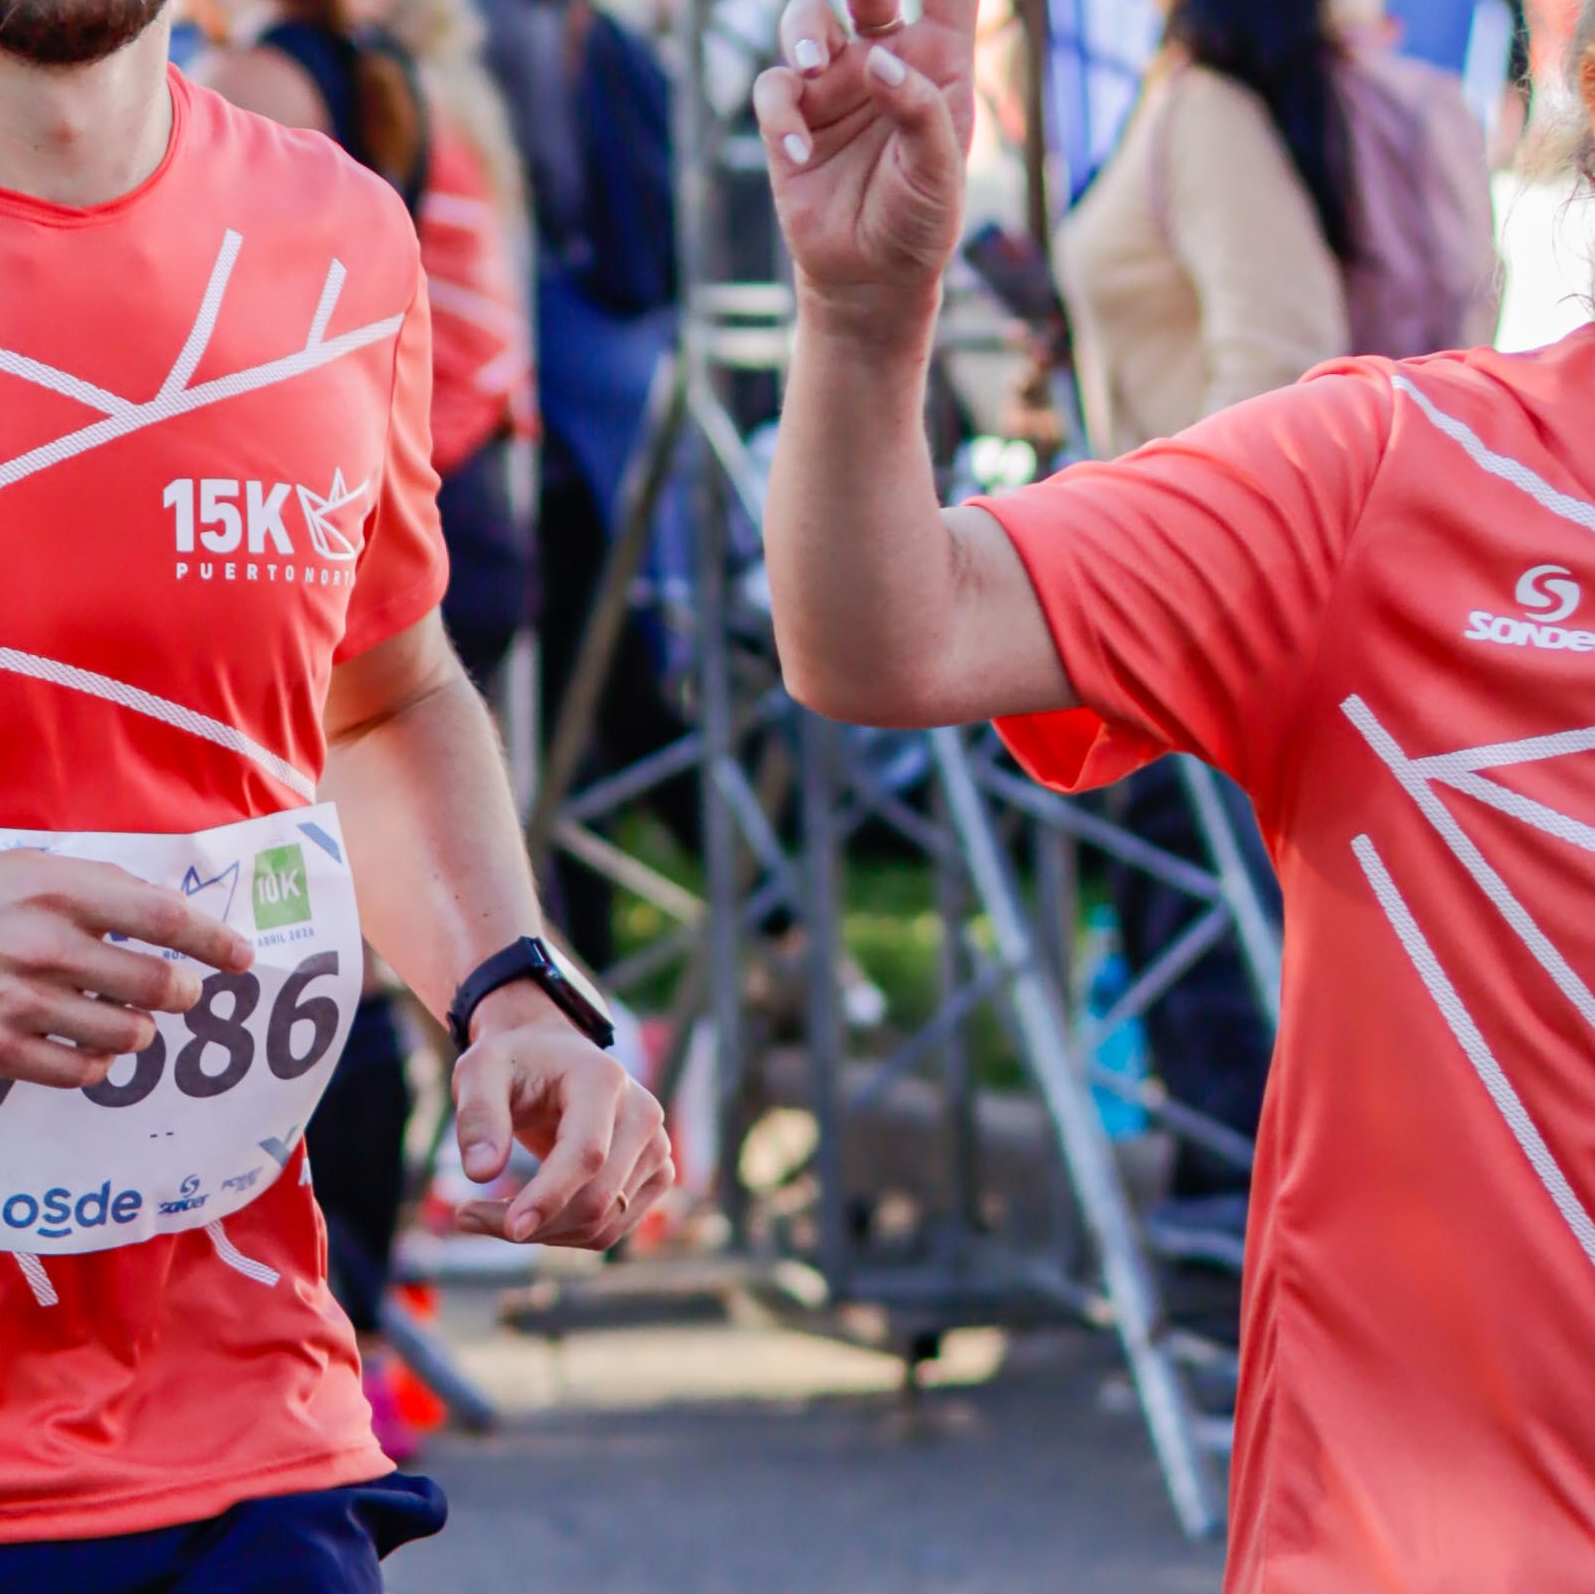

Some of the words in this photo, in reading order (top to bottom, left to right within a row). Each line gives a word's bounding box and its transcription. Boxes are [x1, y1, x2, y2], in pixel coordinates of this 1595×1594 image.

[163, 478, 295, 554] 15K
[176, 562, 295, 581] PUERTO
[1464, 609, 1595, 652] SONDe
[258, 867, 302, 905] 10K
[2, 1179, 143, 1229] osde
